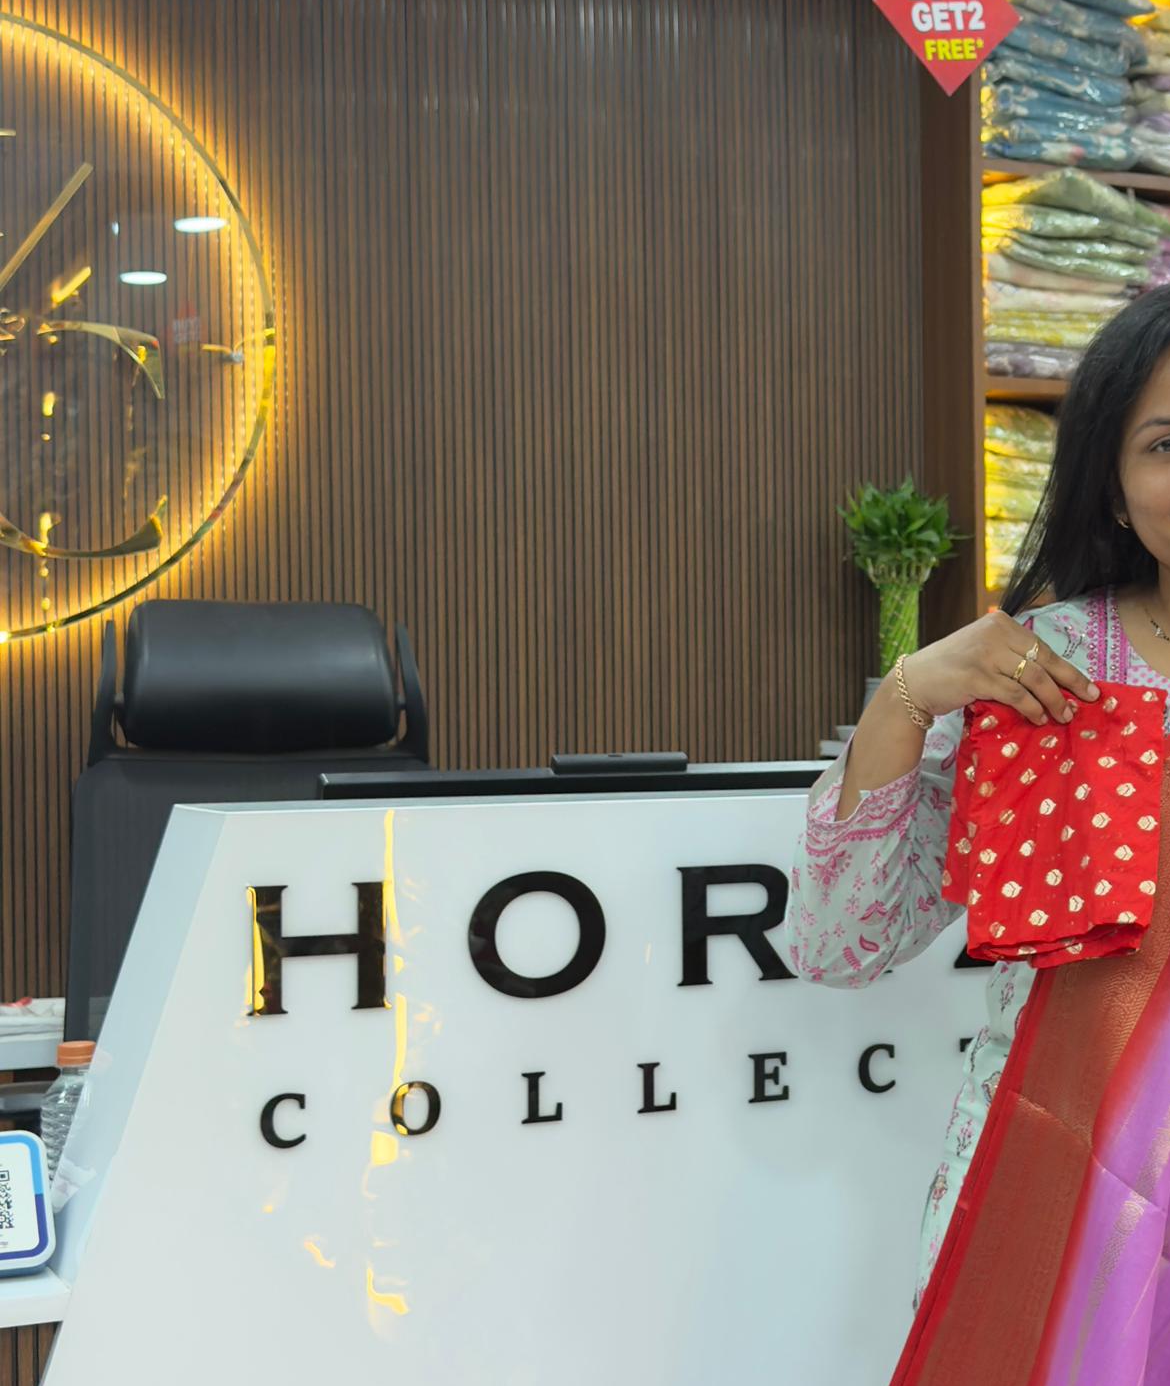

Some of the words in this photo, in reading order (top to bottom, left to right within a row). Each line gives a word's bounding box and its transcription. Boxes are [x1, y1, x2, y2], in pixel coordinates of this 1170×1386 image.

[911, 1, 986, 32] GET2
[246, 863, 998, 1016] HOR
[259, 1037, 975, 1149] COLLEC
